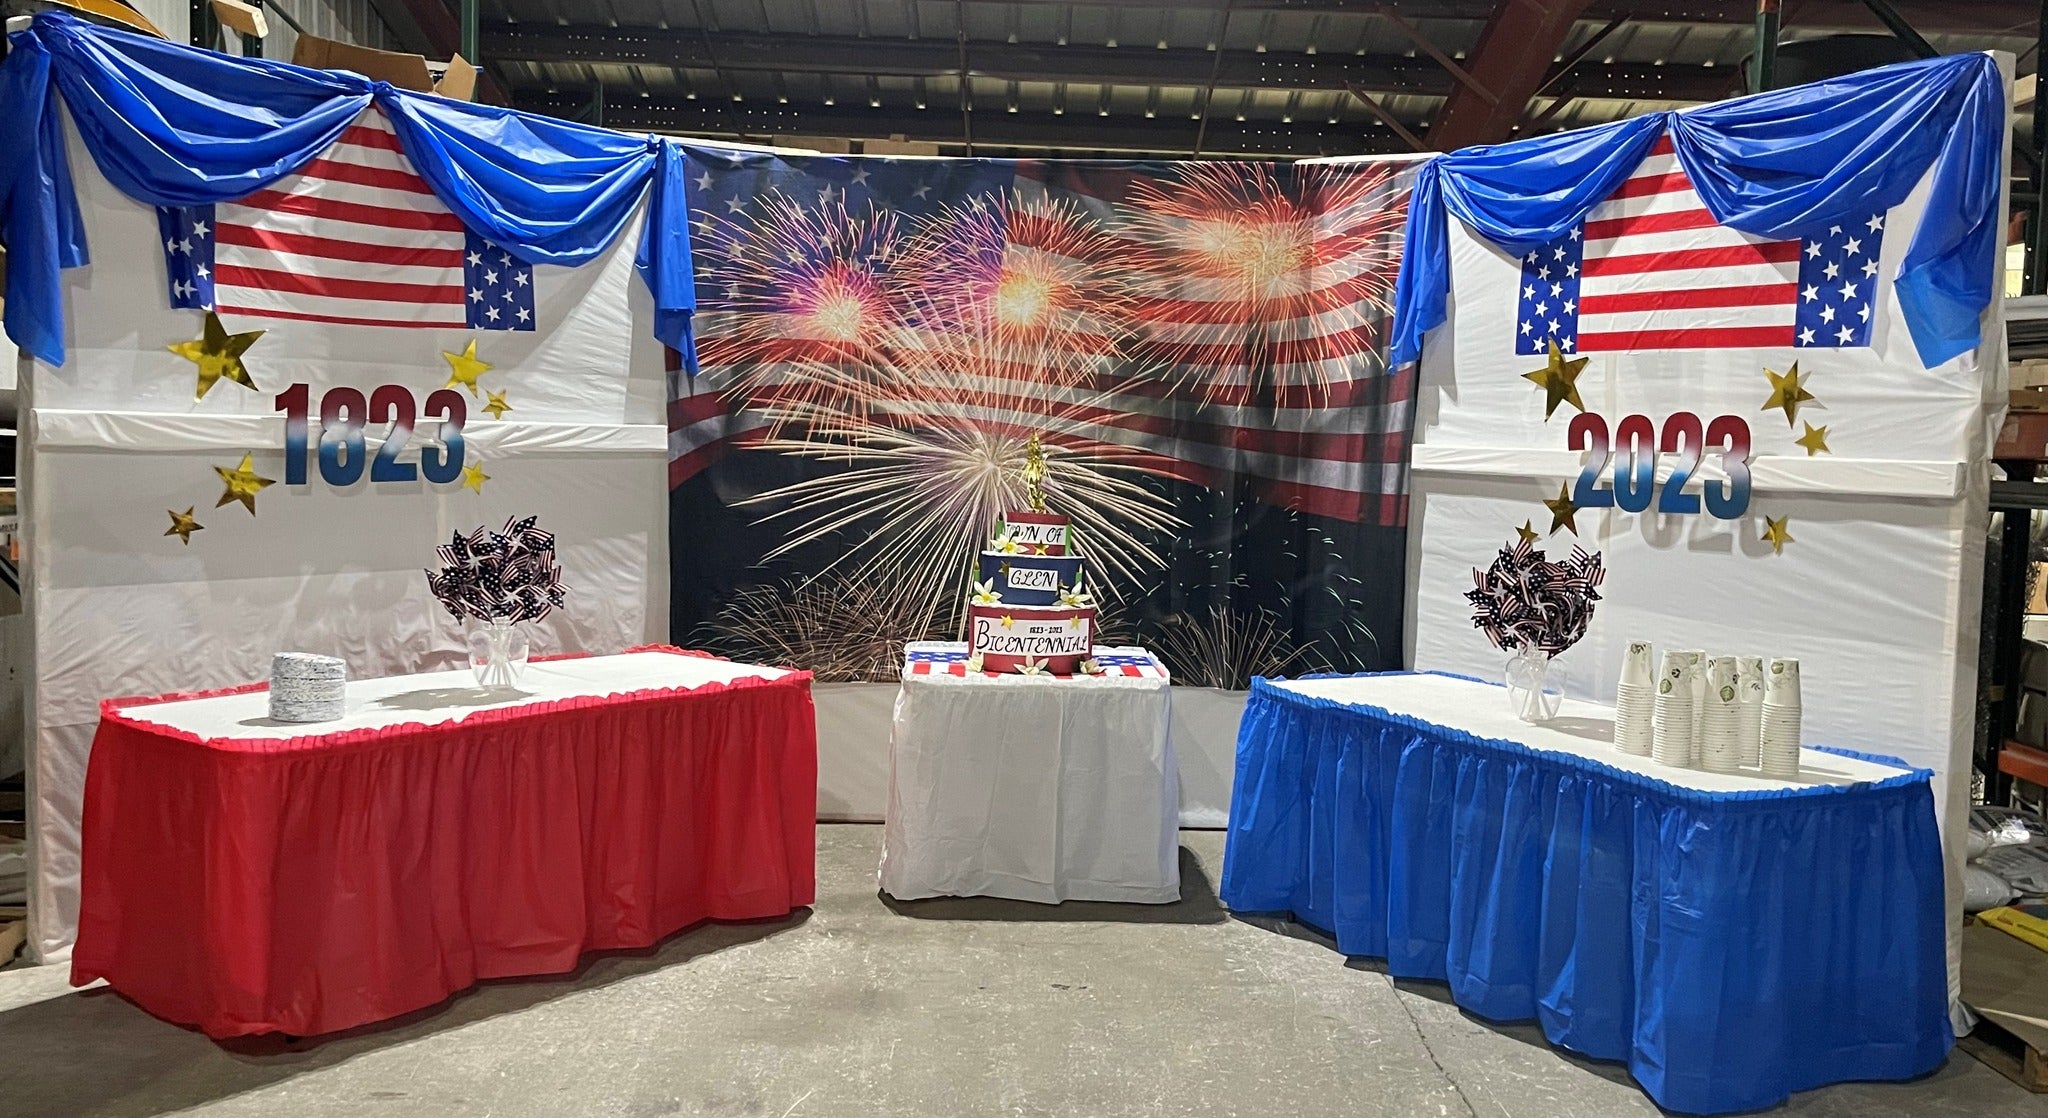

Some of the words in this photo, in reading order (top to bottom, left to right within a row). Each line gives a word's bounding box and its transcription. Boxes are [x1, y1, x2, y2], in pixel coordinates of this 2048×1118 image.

[275, 383, 467, 486] 1823
[1568, 411, 1752, 520] 2023
[1046, 527, 1065, 543] OF
[1010, 569, 1056, 588] GLEN
[976, 619, 1088, 653] BICENTENNIAL
